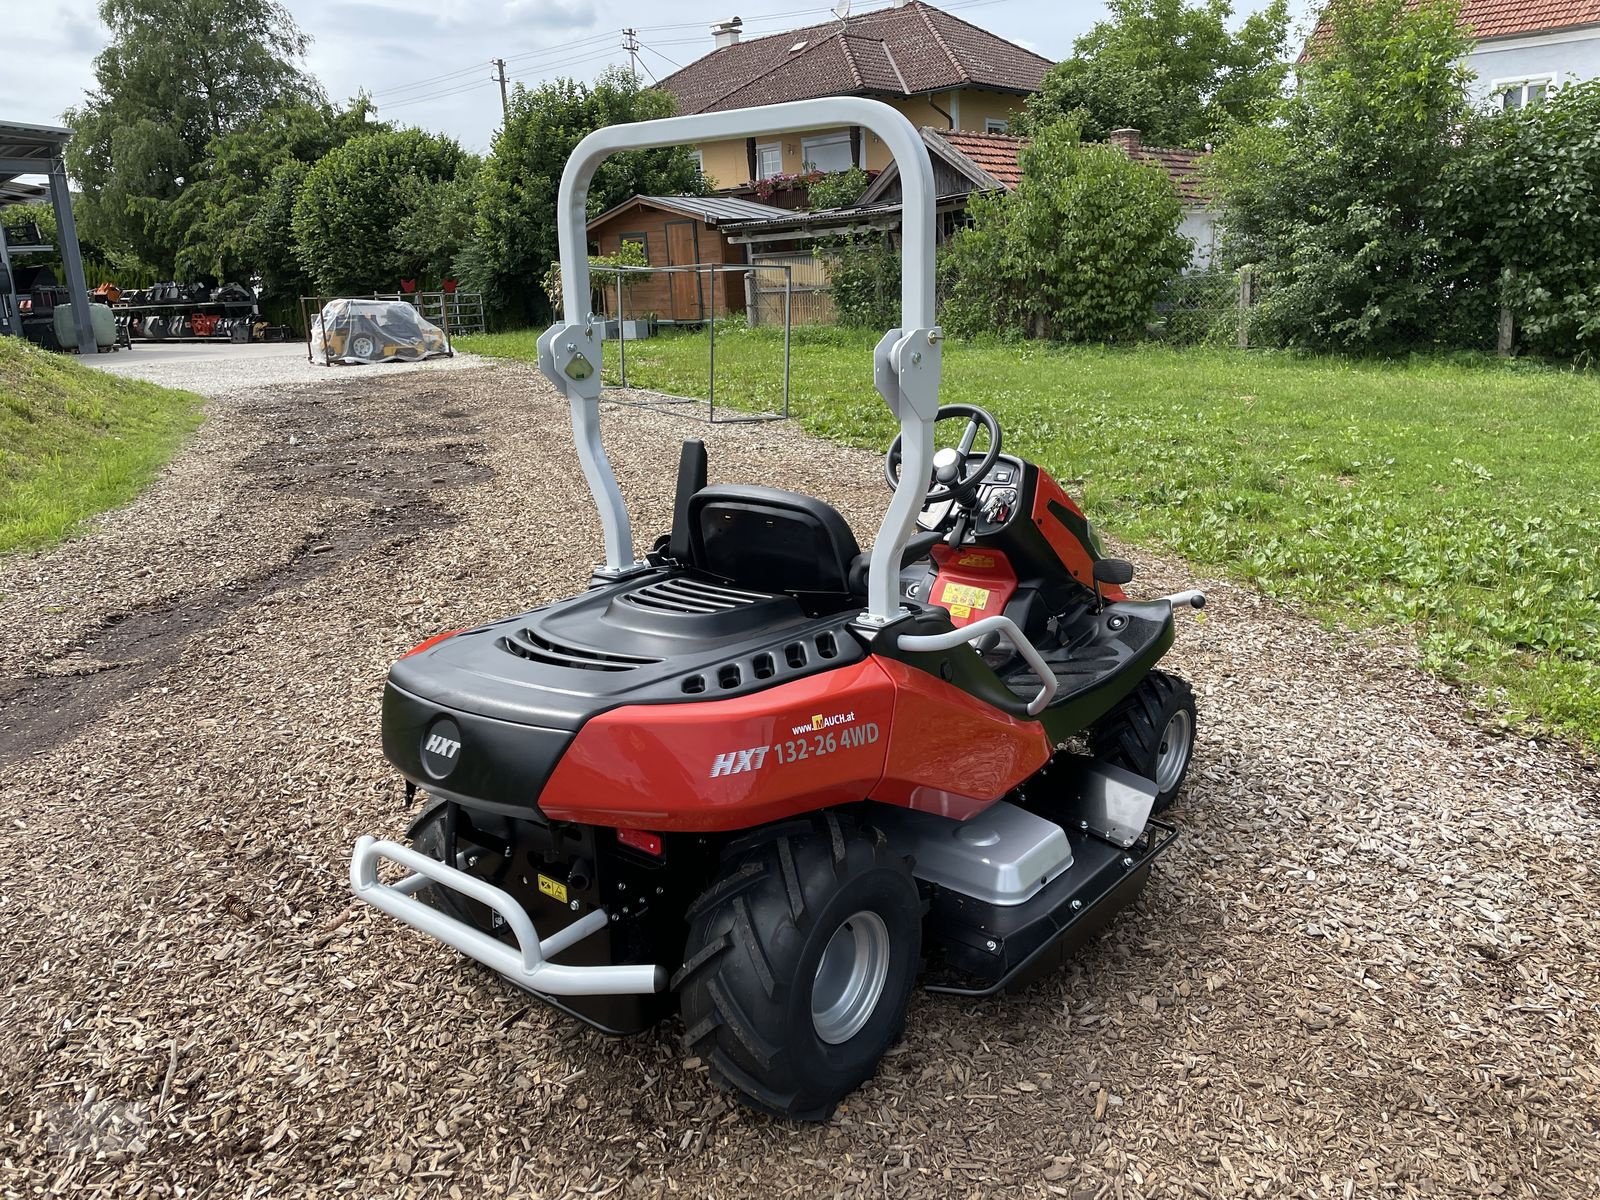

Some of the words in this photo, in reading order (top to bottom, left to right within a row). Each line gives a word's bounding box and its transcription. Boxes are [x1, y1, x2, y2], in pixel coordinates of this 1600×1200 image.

[792, 711, 855, 735] www.MAUCH.at
[425, 733, 461, 759] HXT
[709, 745, 770, 778] HXT
[774, 732, 837, 765] 132-26
[840, 722, 879, 749] 4WD
